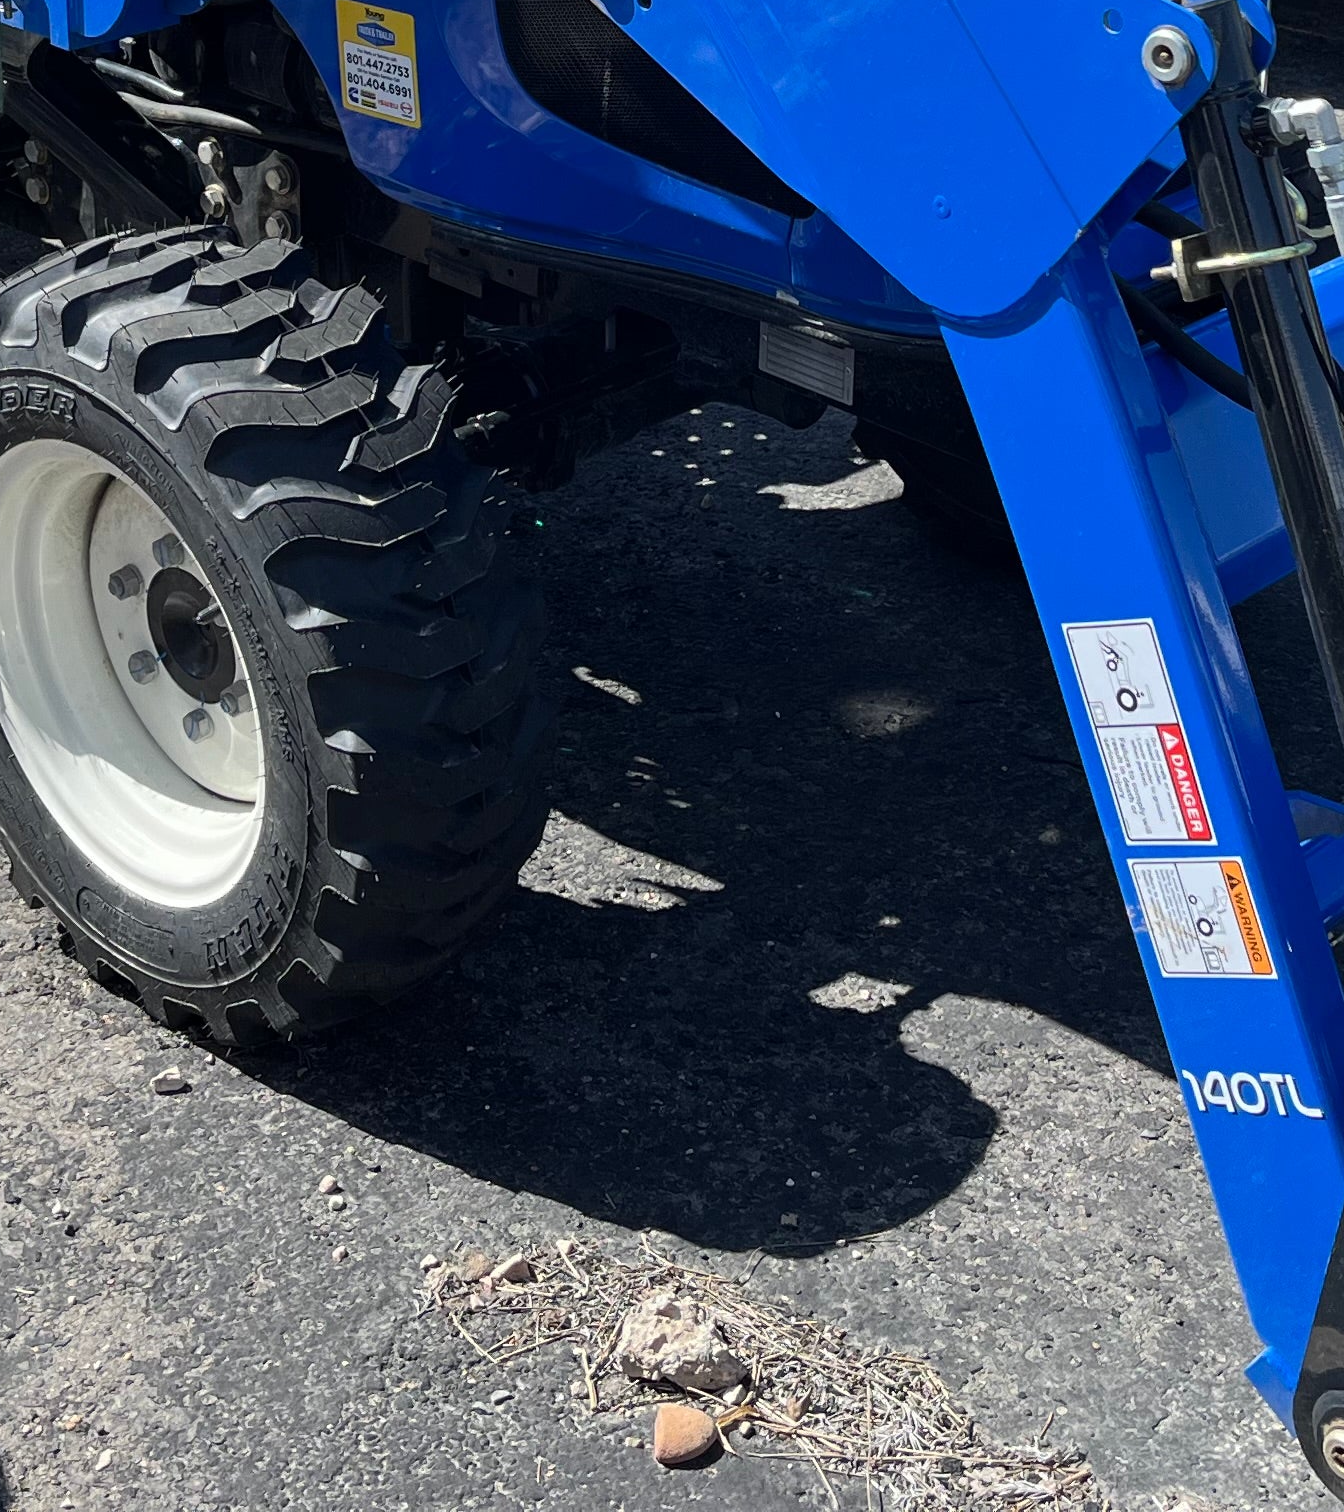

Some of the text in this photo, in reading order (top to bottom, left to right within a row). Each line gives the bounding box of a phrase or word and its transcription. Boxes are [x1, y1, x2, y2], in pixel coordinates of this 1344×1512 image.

[347, 53, 410, 79] 801.447.2753
[1170, 754, 1204, 833] DANGER
[1234, 893, 1263, 963] WARNING
[1181, 1069, 1325, 1119] 140TL
